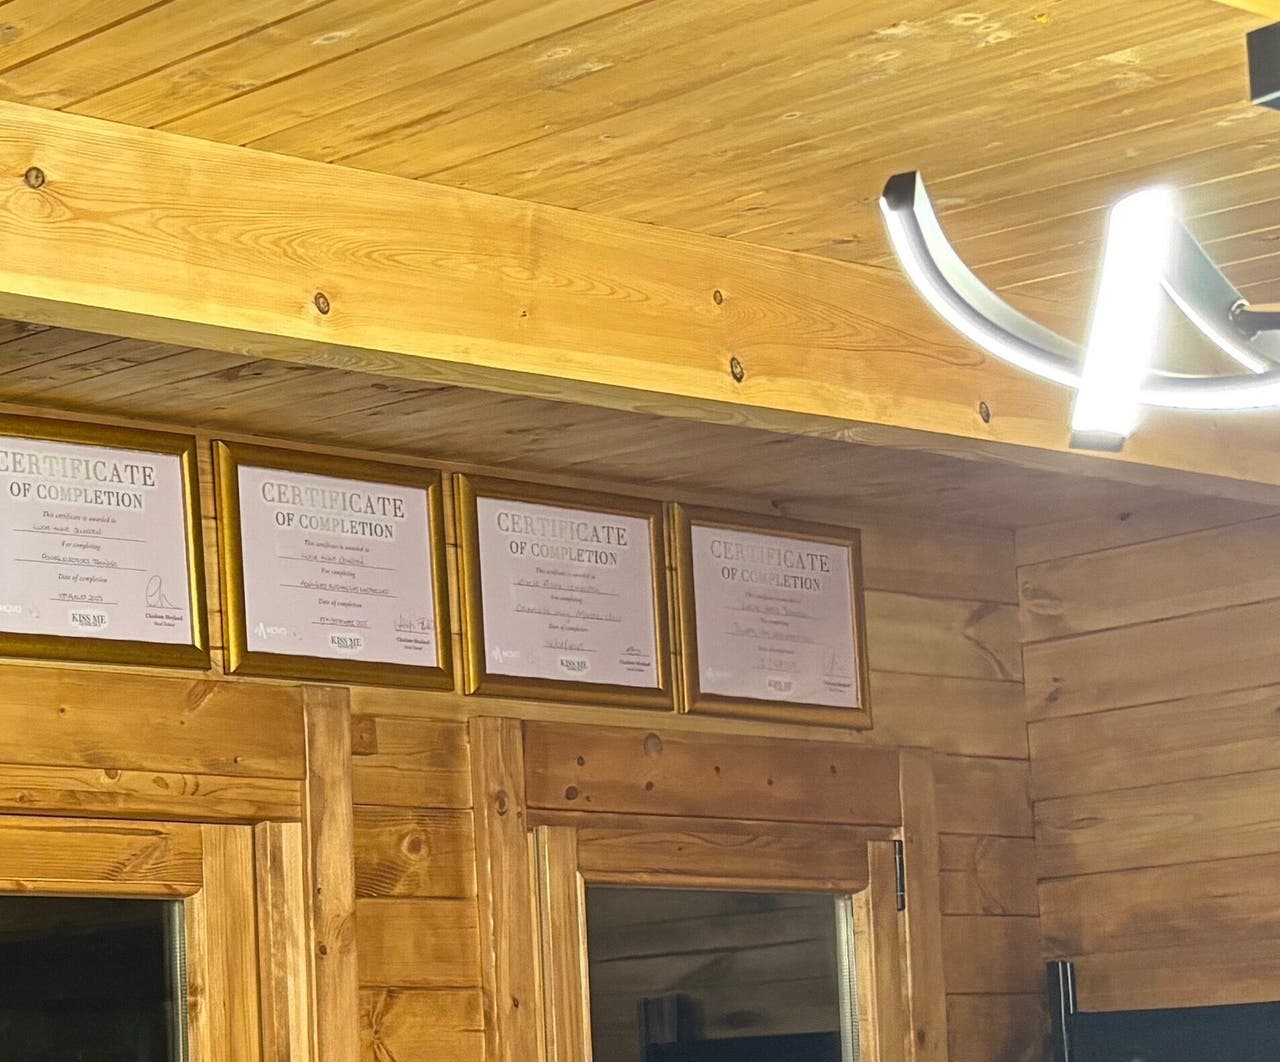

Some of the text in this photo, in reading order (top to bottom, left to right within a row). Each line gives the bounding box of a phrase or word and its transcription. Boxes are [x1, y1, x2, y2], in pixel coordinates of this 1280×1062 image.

[9, 481, 143, 509] OF COMPLETION
[261, 482, 405, 518] CERTIFICATE
[276, 511, 394, 539] OF COMPLETION
[497, 512, 627, 546] CERTIFICATE
[509, 540, 617, 565] OF COMPLETION
[721, 566, 737, 580] OF
[72, 613, 91, 624] KISS
[92, 615, 106, 625] ME
